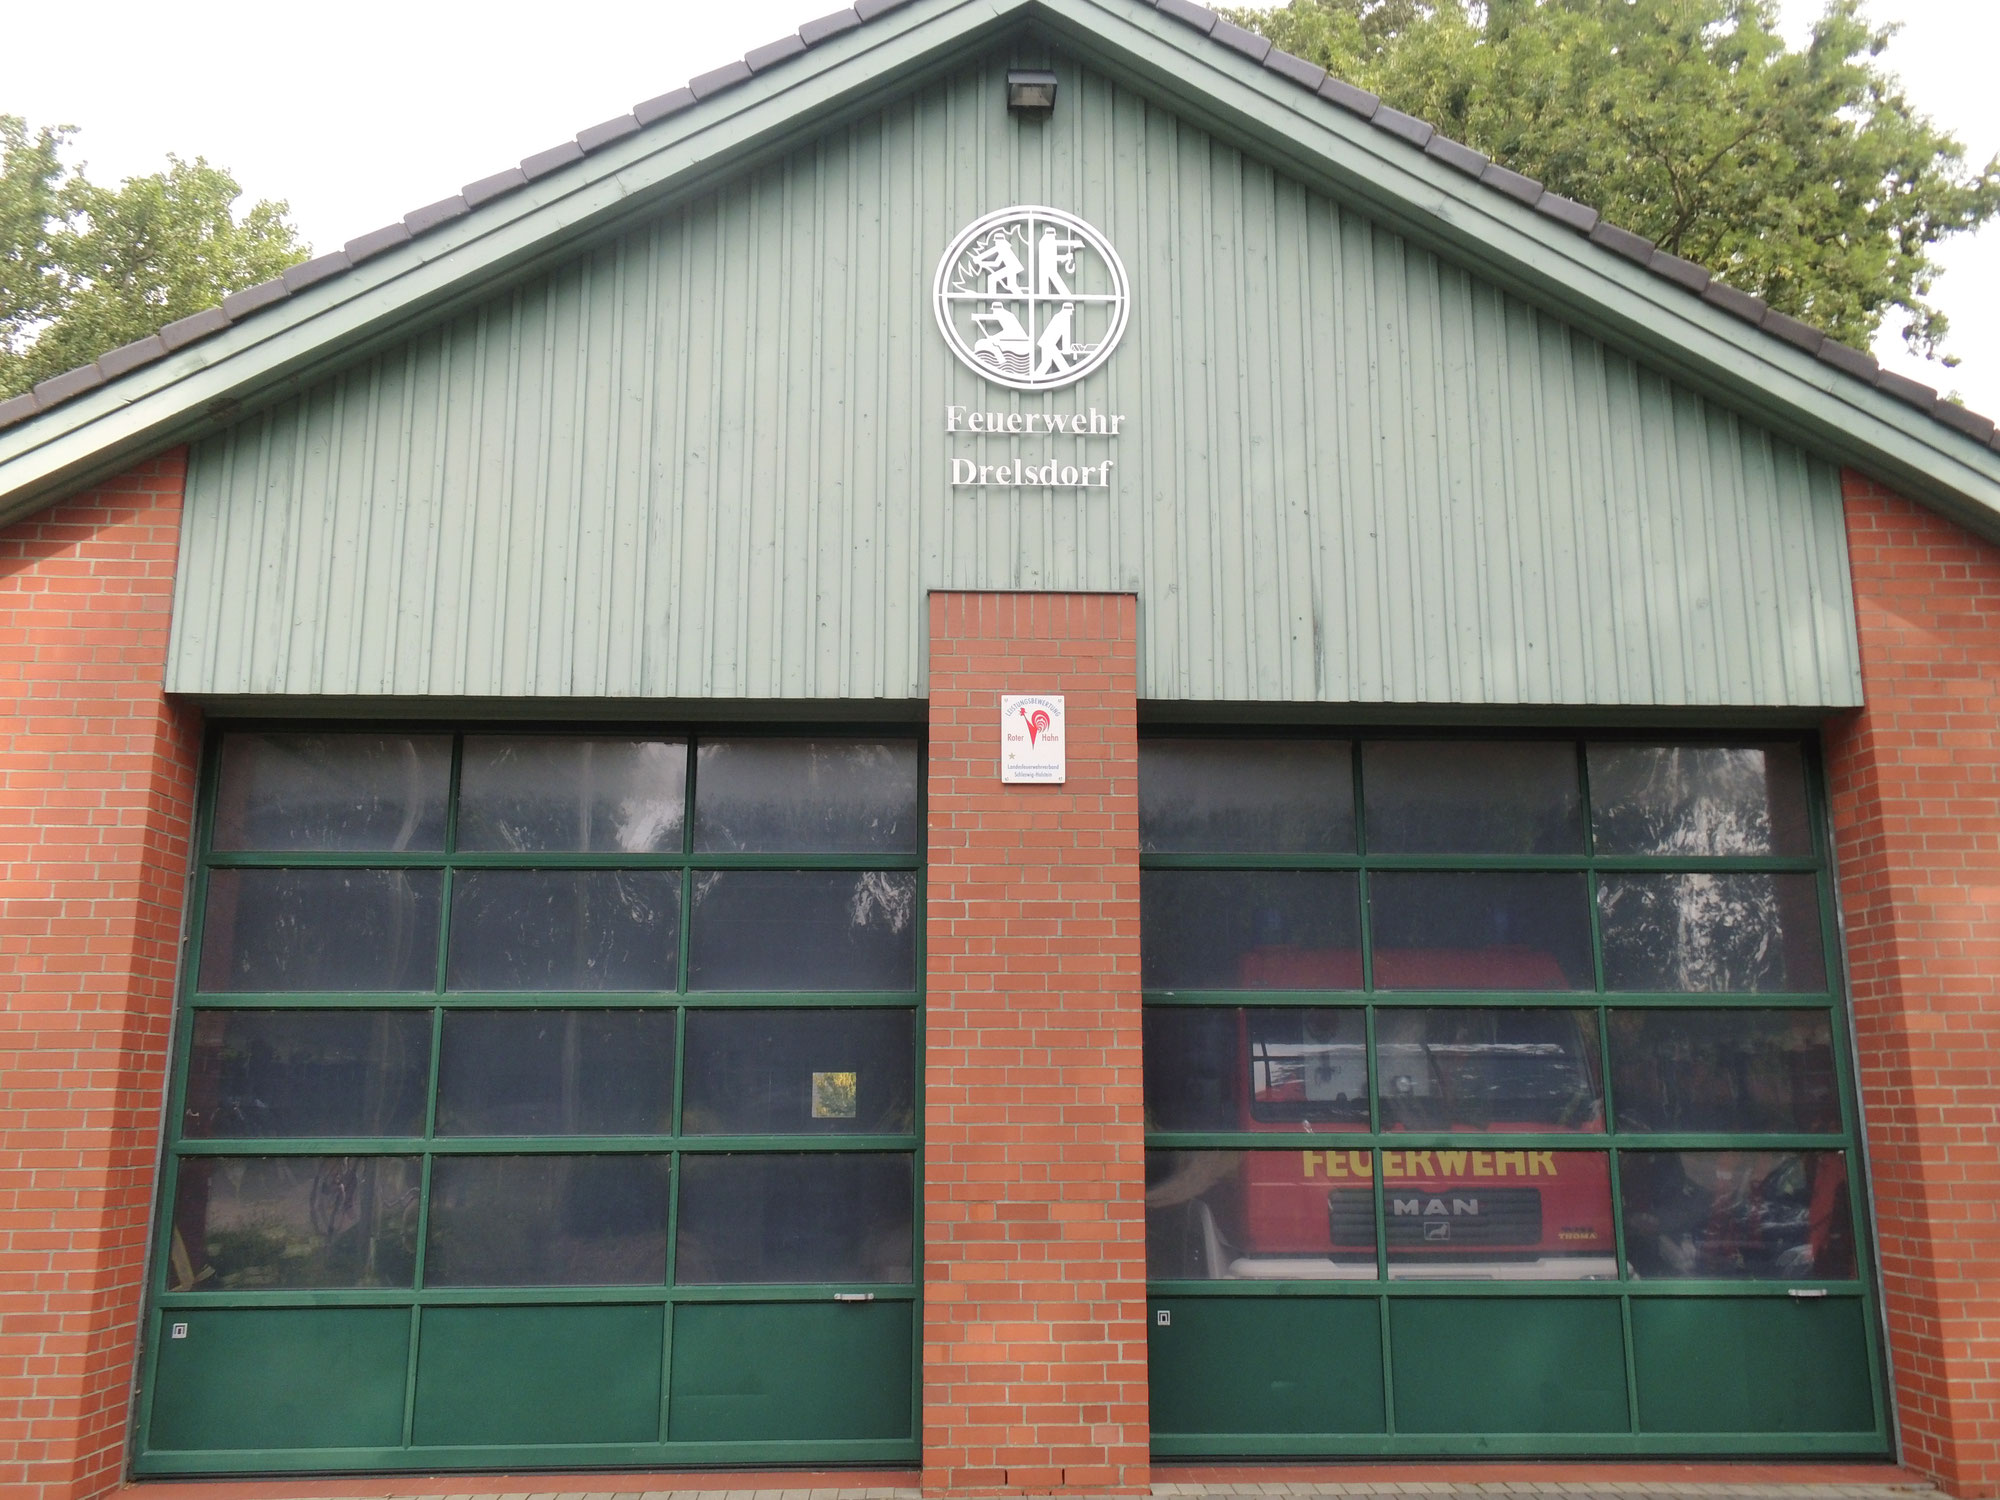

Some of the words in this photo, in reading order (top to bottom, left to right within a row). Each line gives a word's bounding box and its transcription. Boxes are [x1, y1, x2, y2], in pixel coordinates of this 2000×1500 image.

[944, 405, 1126, 435] Feuerwehr
[950, 457, 1114, 487] Drelsdorf
[1005, 697, 1062, 717] LEISTUNGSBEWERTUNG
[1007, 733, 1024, 742] Roter
[1042, 733, 1059, 742] Hahn
[1302, 1150, 1558, 1177] FEUERWEHR
[1393, 1198, 1479, 1216] MAN
